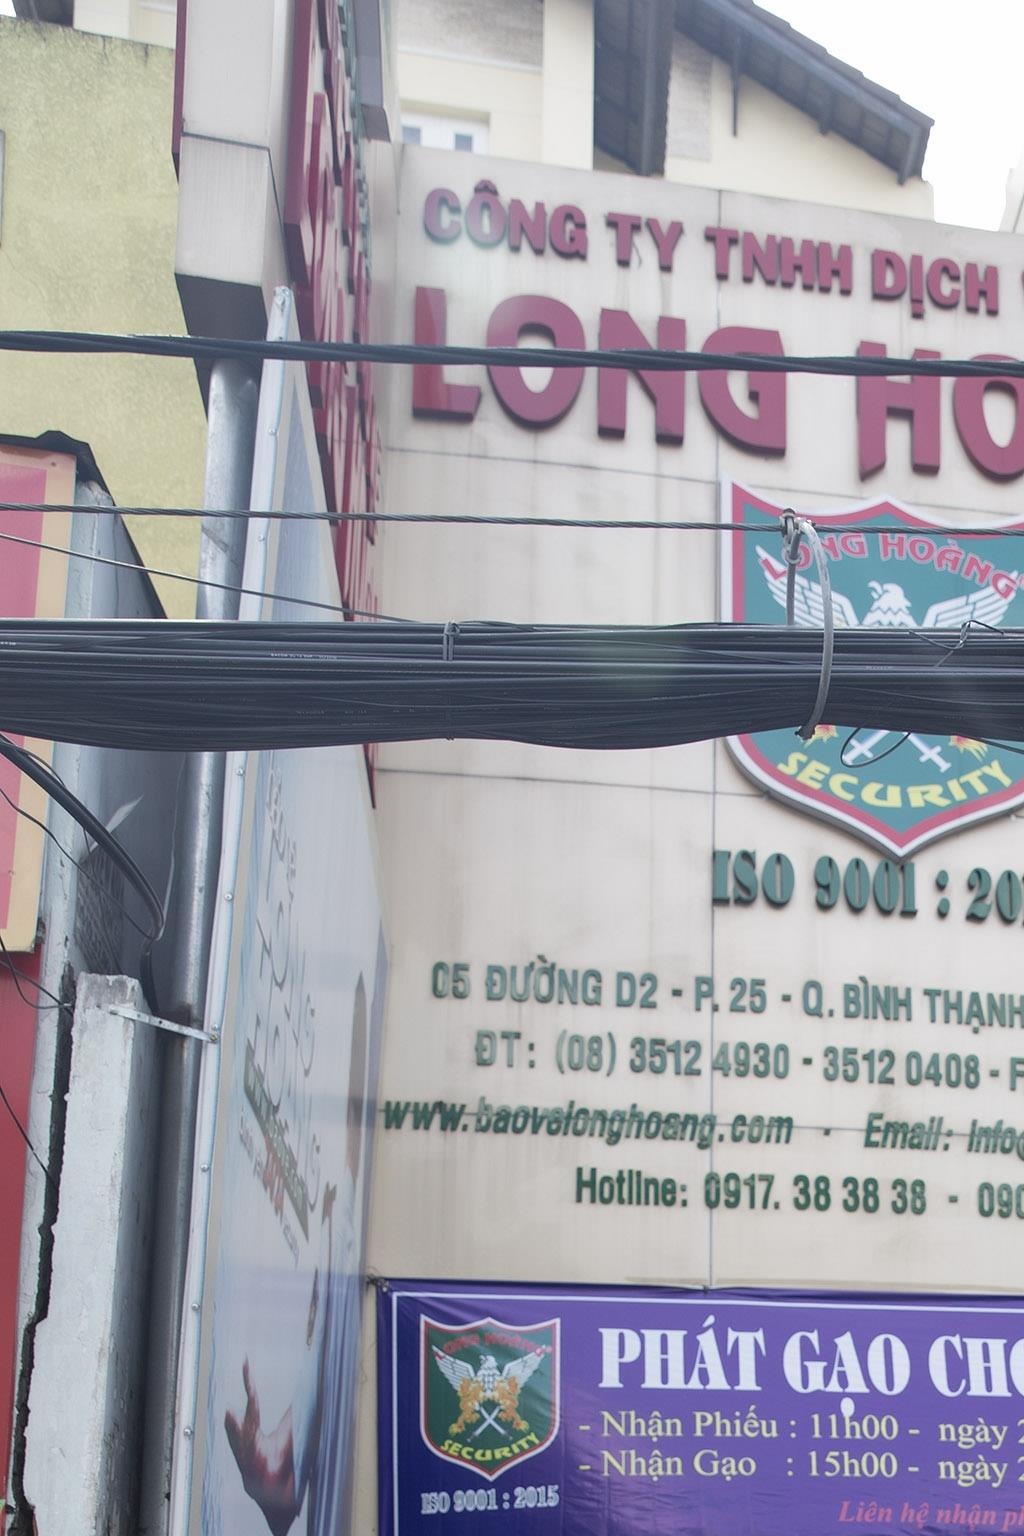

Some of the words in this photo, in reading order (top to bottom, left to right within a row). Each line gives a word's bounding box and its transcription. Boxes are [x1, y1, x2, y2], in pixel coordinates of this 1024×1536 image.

[424, 179, 588, 260] CÔNG
[606, 212, 684, 272] TY
[705, 226, 852, 296] TNHH
[871, 248, 999, 319] DỊCH
[412, 285, 788, 458] LONG
[776, 750, 1014, 809] SECURITY
[712, 848, 796, 908] ISO
[814, 855, 918, 918] 9001
[432, 960, 471, 999] 05
[486, 954, 603, 1007] ĐƯỜNG
[615, 971, 658, 1010] D2
[844, 975, 912, 1021] BÌNH
[555, 1029, 617, 1078] (08)
[630, 1037, 701, 1077] 3512
[712, 1041, 790, 1080] 4930
[823, 1046, 895, 1086] 3512
[905, 1050, 981, 1090] 0408
[383, 1098, 794, 1150] www.baovelonghoang.com
[864, 1112, 951, 1152] Email:
[575, 1167, 688, 1208] Hotline:
[793, 1175, 831, 1213] 38
[842, 1177, 880, 1214] 38
[891, 1178, 927, 1215] 38
[597, 1314, 766, 1392] PHÁT
[783, 1330, 911, 1418] GẠO
[440, 1432, 540, 1461] SECURITY
[600, 1411, 684, 1448] Nhận
[693, 1404, 778, 1439] Phiếu
[810, 1413, 900, 1441] 11h00
[938, 1420, 1008, 1450] ngày
[600, 1450, 684, 1484] Nhận
[693, 1450, 757, 1481] Gạo
[808, 1450, 899, 1478] 15h00
[938, 1457, 1008, 1489] ngày
[420, 1491, 451, 1515] ISO
[453, 1488, 498, 1513] 9001
[513, 1484, 560, 1510] 2015
[838, 1500, 893, 1523] Liên
[900, 1502, 929, 1529] hệ
[936, 1503, 997, 1531] nhận
